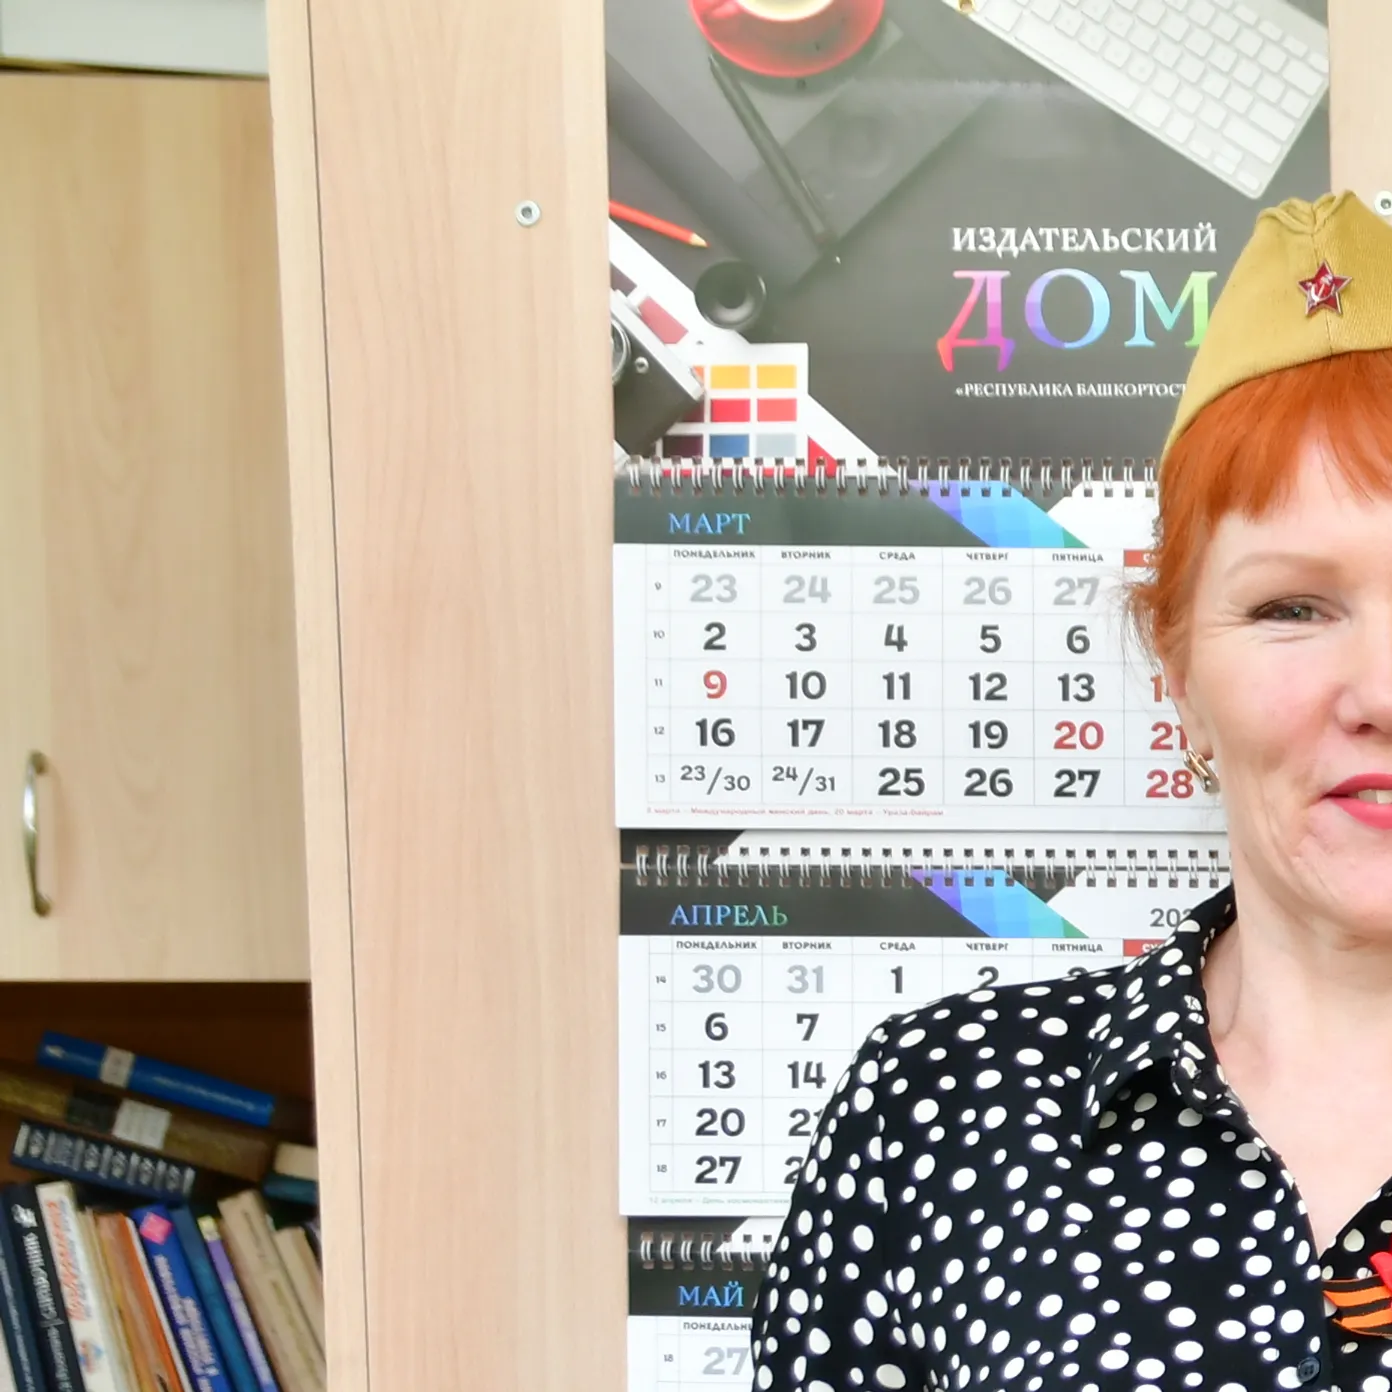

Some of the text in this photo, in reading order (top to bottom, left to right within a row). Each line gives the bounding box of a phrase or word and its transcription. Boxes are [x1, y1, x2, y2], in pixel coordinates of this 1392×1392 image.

[951, 222, 1218, 258] ИЗДАТЕЛЬСКИЙ
[936, 267, 1217, 372] ДОМ
[955, 382, 1188, 398] «РЕСПУБЛИКА БАШКОРТОСТ
[667, 512, 752, 535] МАРТ
[673, 549, 1105, 563] ПОНЕДЕЛЬНИК ВТОРНИК СРЕДА ЧЕТВЕРГ ПЯТНИЦА
[690, 573, 738, 604] 23
[782, 574, 832, 604] 24
[873, 575, 922, 605] 25
[963, 576, 1013, 606] 26
[1053, 577, 1101, 607] 27
[653, 622, 1091, 655] 10 2 3 4 5 6
[702, 669, 728, 700] 9
[785, 671, 828, 700] 10
[882, 671, 912, 701] 11
[968, 672, 1009, 702] 12
[1057, 673, 1097, 703] 13
[1150, 674, 1164, 702] 1
[653, 717, 1189, 751] 12 16 17 18 19 20 21
[654, 774, 666, 783] 13
[877, 768, 926, 797] 25
[963, 768, 1014, 798] 26
[1053, 769, 1102, 798] 27
[1145, 768, 1195, 799] 28
[669, 904, 789, 927] АПРЕЛЬ
[676, 940, 1104, 954] ПОНЕДЕЛЬНИК ВТОРНИК СРЕДА ЧЕТВЕРГ ПЯТНИЦА
[655, 975, 667, 985] 14
[691, 964, 743, 994] 30
[786, 965, 825, 994] 31
[890, 965, 903, 994] 1
[655, 1012, 820, 1042] 15 6 7
[655, 1060, 827, 1090] 16 13 14
[655, 1118, 667, 1128] 17
[694, 1107, 746, 1138] 20
[655, 1156, 806, 1186] 18 27 2
[678, 1283, 744, 1307] МАЙ
[663, 1346, 750, 1377] 18 27
